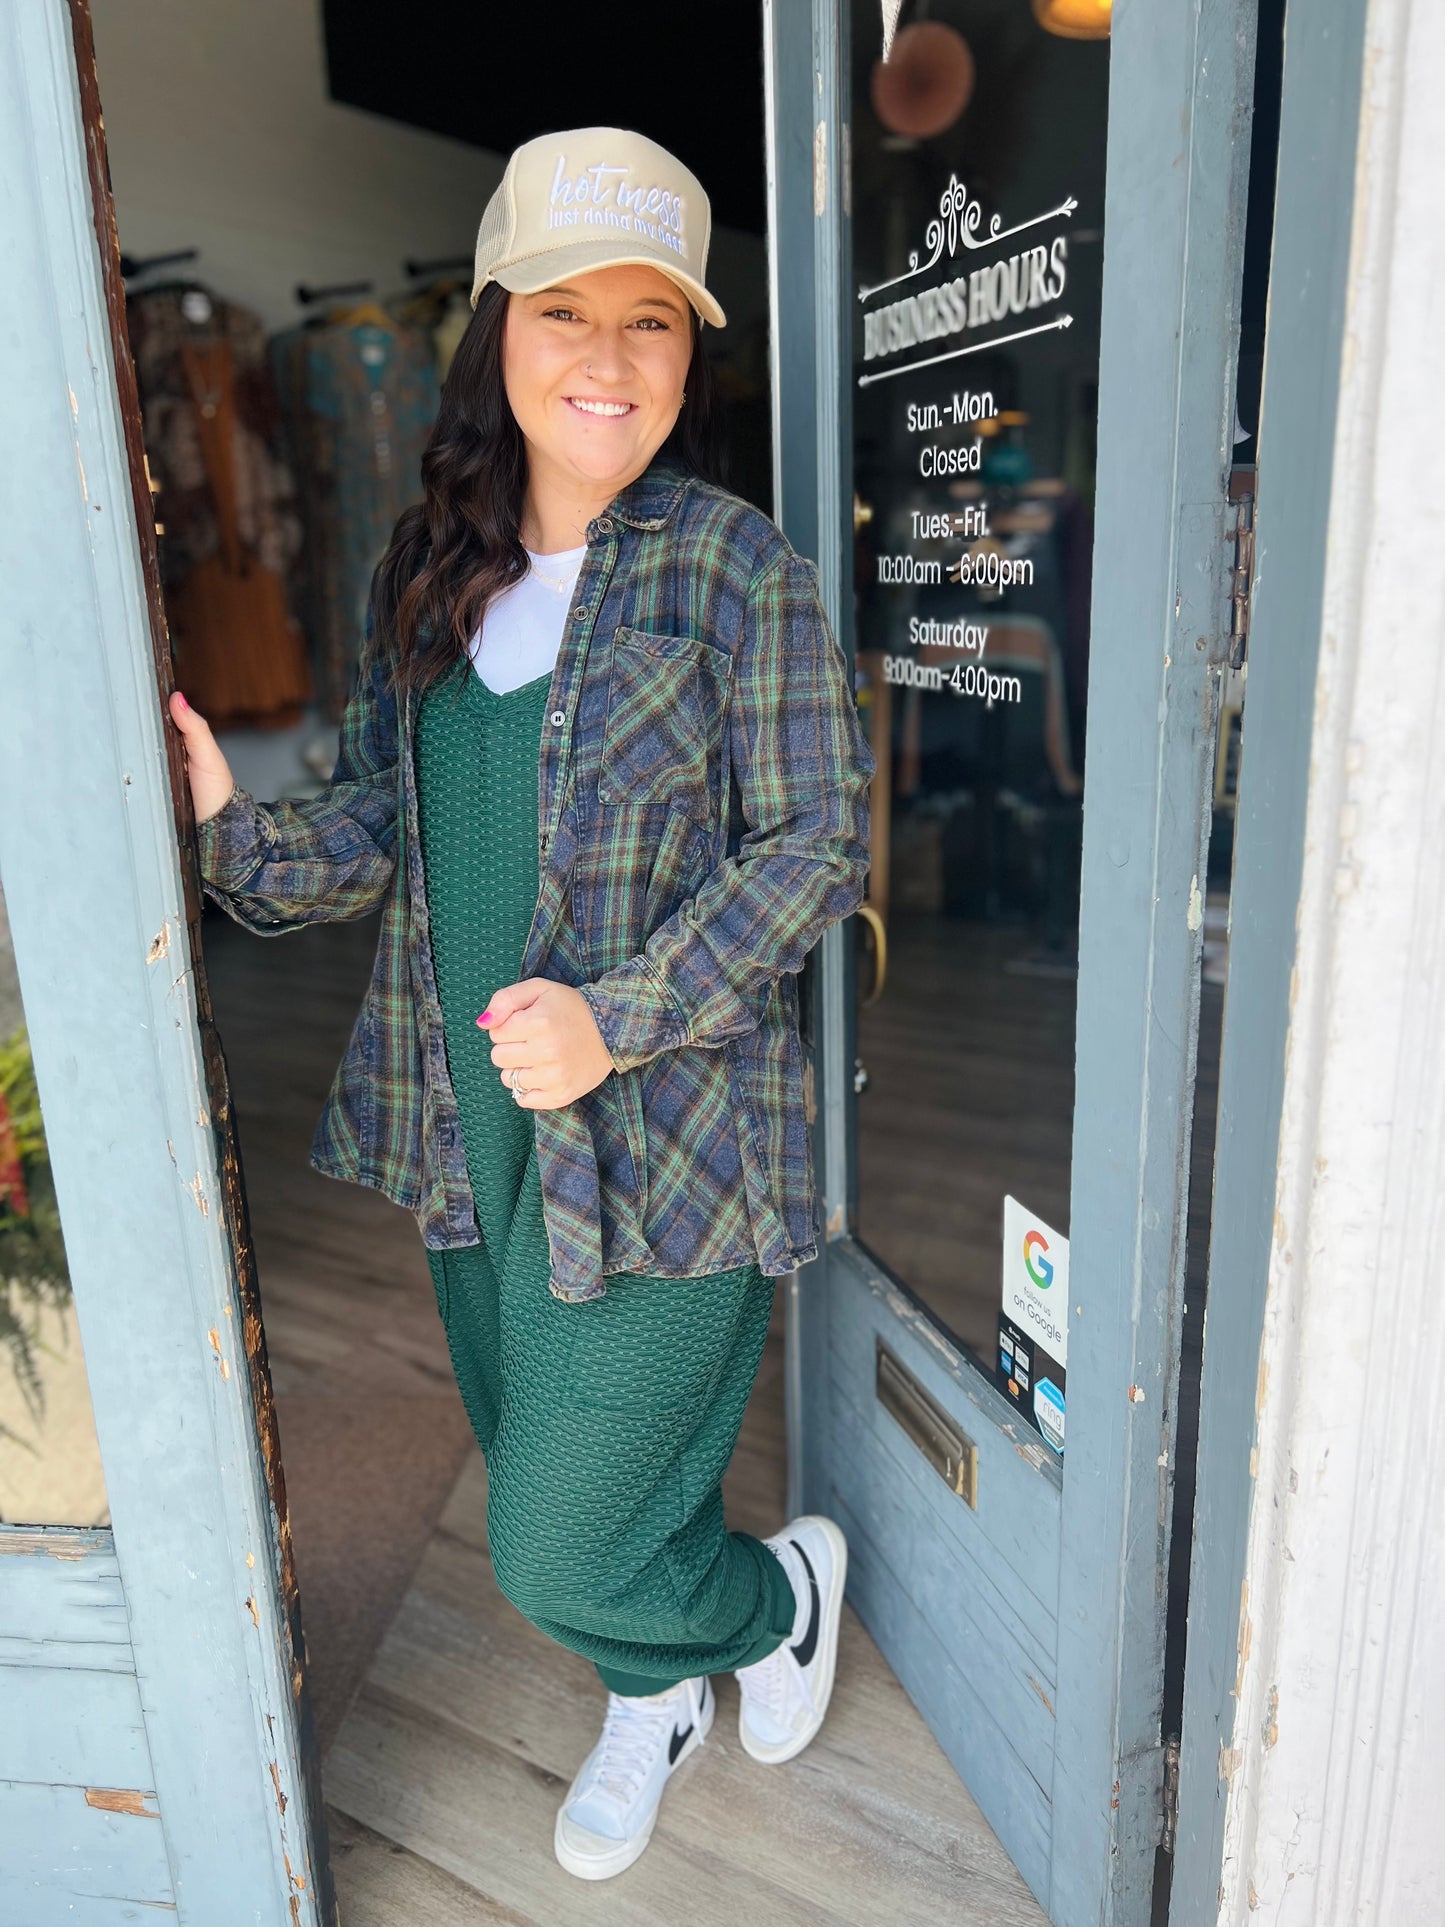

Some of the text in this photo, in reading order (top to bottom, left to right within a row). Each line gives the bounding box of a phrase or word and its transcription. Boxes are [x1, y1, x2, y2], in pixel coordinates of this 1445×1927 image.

[551, 154, 681, 232] hot mess
[548, 206, 579, 230] just
[864, 237, 1067, 360] BUSINESS HOURS
[907, 391, 999, 432] Sun.-Mon.
[920, 437, 983, 477] Closed
[911, 502, 991, 539] Tues.-Fri.
[878, 555, 941, 584] 10:00am
[960, 553, 1033, 594] 6:00pm
[909, 617, 988, 659] Saturday
[1024, 1230, 1054, 1289] G
[1014, 1294, 1025, 1311] on
[1027, 1303, 1061, 1342] Google
[1024, 1286, 1051, 1316] follow us
[1043, 1401, 1061, 1431] ring
